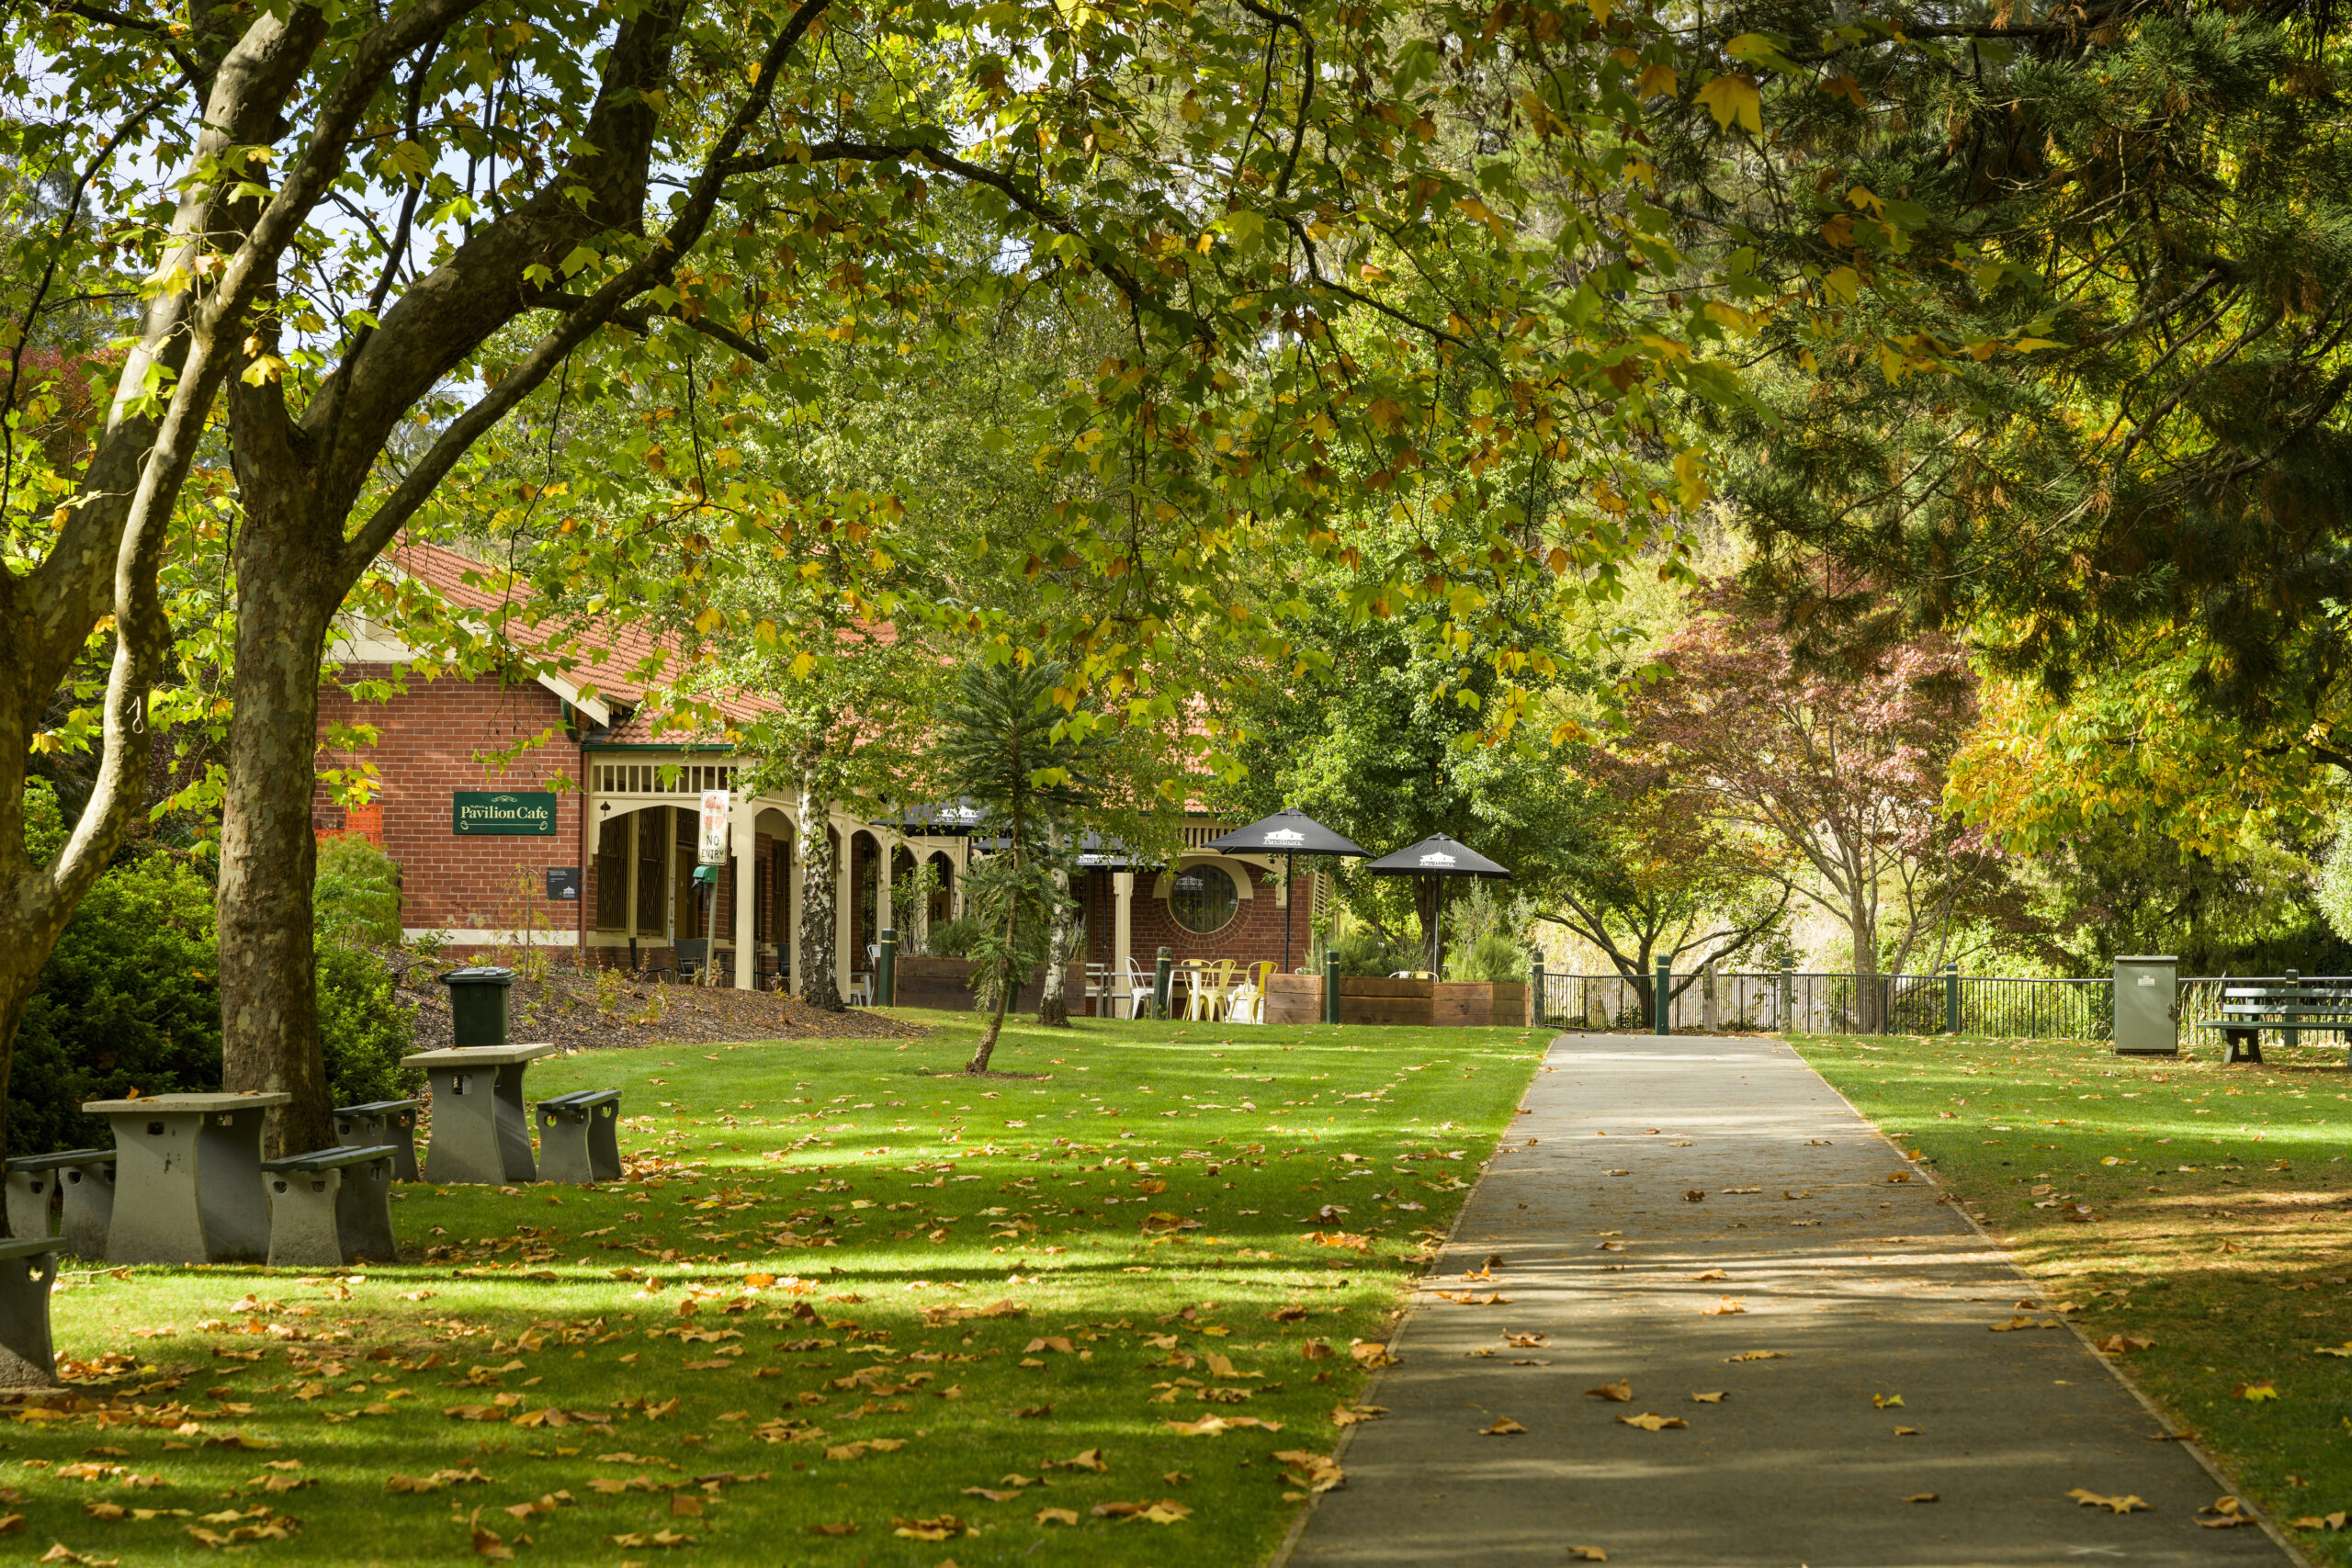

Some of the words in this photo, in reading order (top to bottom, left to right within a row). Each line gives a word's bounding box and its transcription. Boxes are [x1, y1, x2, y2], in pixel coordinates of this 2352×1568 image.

[460, 806, 515, 819] Pavilion
[516, 806, 548, 819] Cafe
[706, 834, 719, 846] NO
[701, 849, 724, 858] ENTRY
